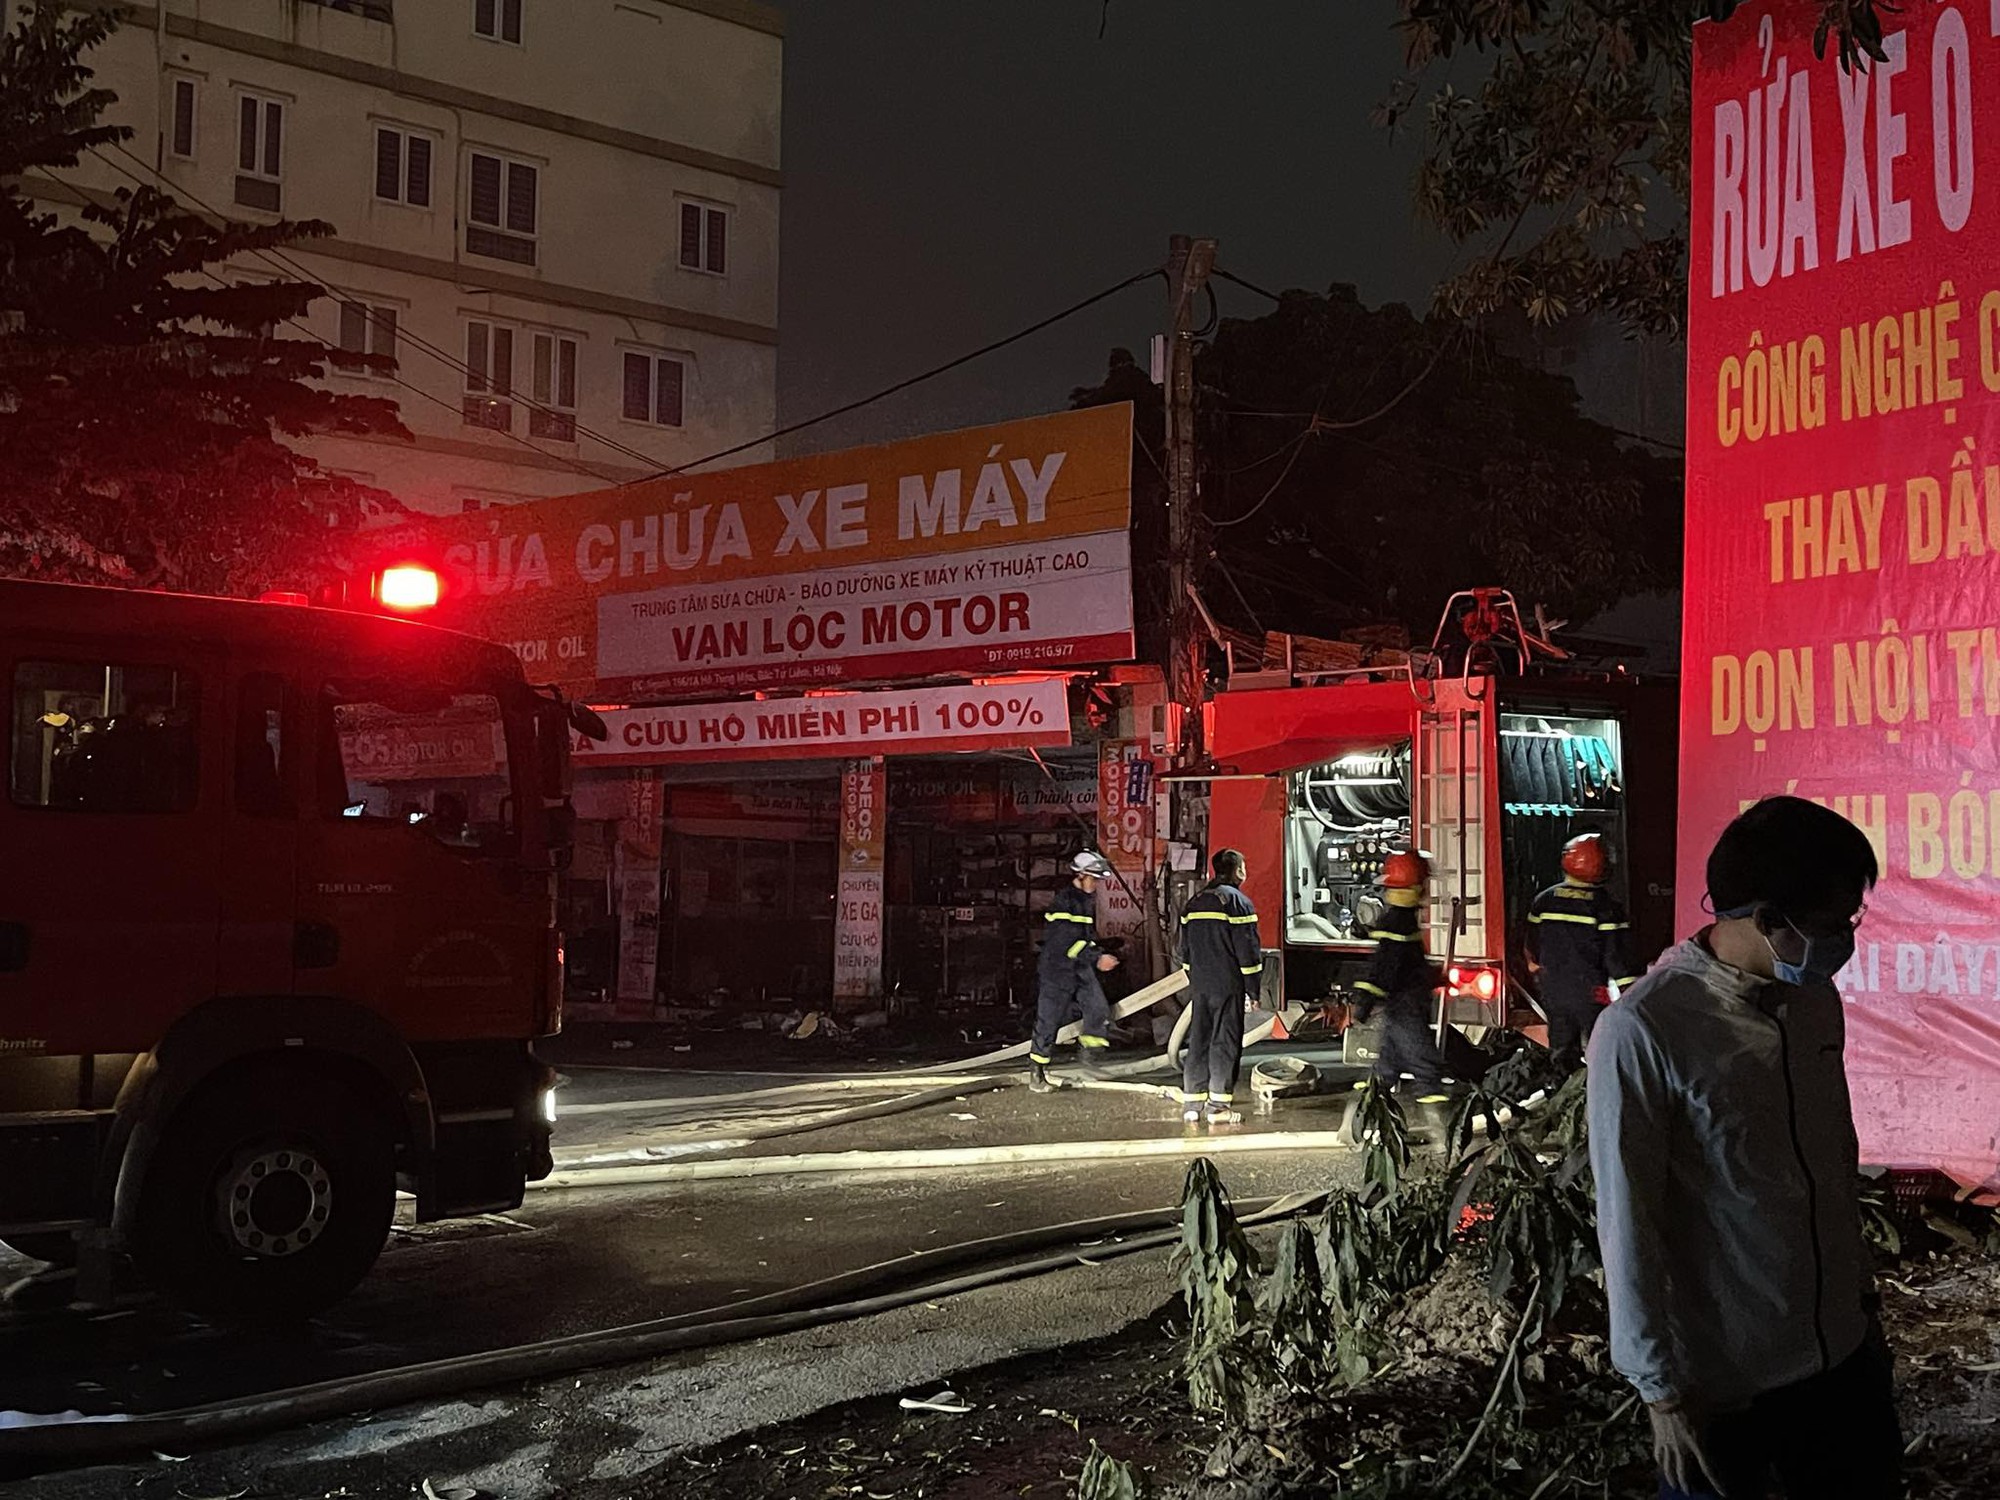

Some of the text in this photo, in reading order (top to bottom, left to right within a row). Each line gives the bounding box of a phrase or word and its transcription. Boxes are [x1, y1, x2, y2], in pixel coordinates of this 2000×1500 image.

[1712, 14, 1819, 298] RỬA
[1836, 29, 1911, 262] XE
[1718, 330, 1826, 447] CÔNG
[1840, 280, 1963, 424] NGHỆ
[575, 490, 753, 582] CHỮA
[775, 484, 868, 555] XE
[899, 445, 1066, 540] MÁY
[1764, 484, 1887, 583] THAY
[631, 603, 677, 619] TRUNG
[900, 571, 919, 589] XE
[924, 563, 959, 585] MÁY
[964, 559, 986, 581] KỸ
[990, 554, 1047, 579] THUẬT
[1052, 550, 1090, 571] CAO
[672, 592, 1030, 665] VẠN LỘC MOTOR
[558, 636, 586, 658] OIL
[1711, 646, 1815, 752] DỌN
[1833, 618, 1930, 743] NỘI
[623, 716, 687, 746] CỨU
[700, 713, 745, 745] HỘ
[758, 704, 846, 739] MIỄN
[859, 700, 920, 734] PHÍ
[935, 697, 1044, 730] 100%
[858, 759, 873, 842] ENEOS
[1107, 746, 1120, 853] MOTOR OIL
[1123, 745, 1142, 853] EOS
[841, 902, 879, 921] XE GA
[1840, 942, 1880, 1003] ẠI
